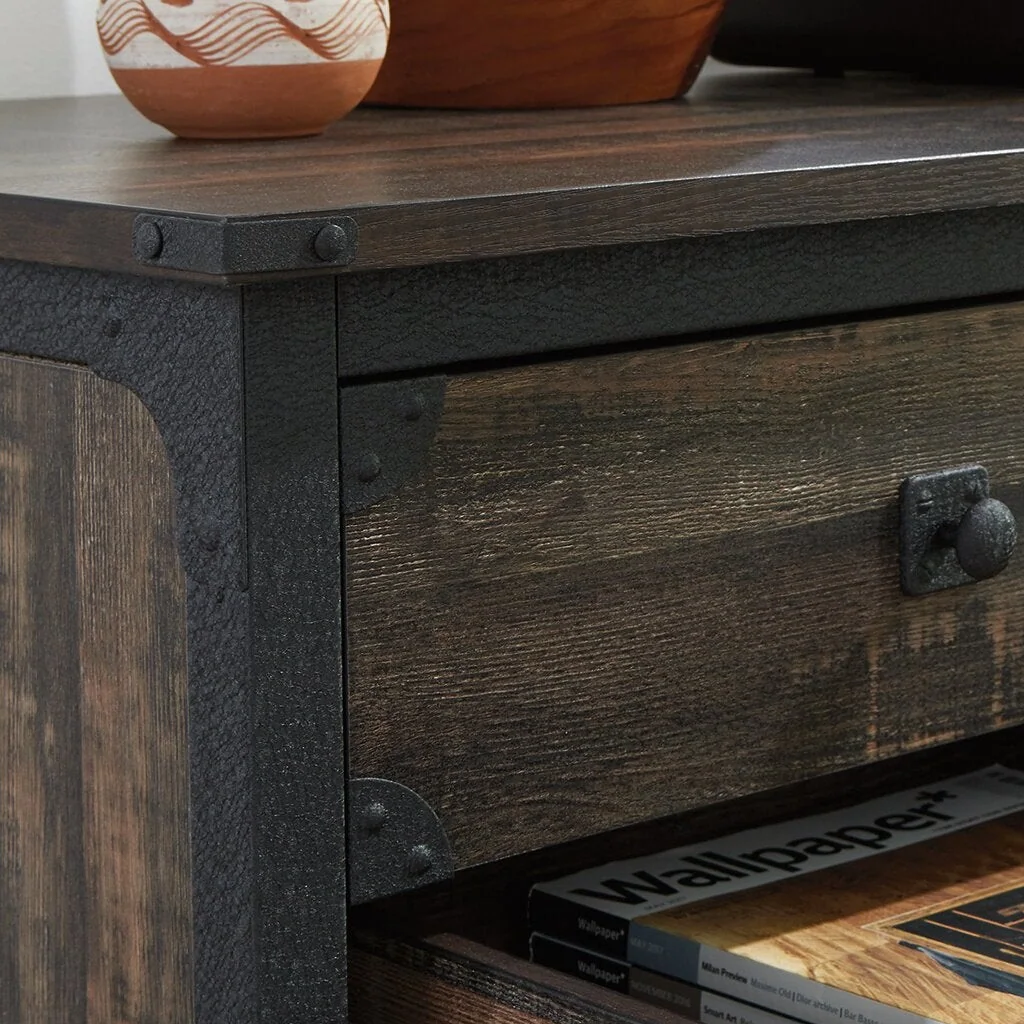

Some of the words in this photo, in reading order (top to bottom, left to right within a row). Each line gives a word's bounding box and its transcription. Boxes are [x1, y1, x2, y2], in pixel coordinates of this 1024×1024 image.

[702, 961, 719, 975] Milan
[721, 968, 747, 984] Preview
[813, 1000, 838, 1015] archive
[844, 1009, 856, 1021] Bar
[704, 1005, 725, 1019] Smart
[726, 1012, 737, 1024] Art
